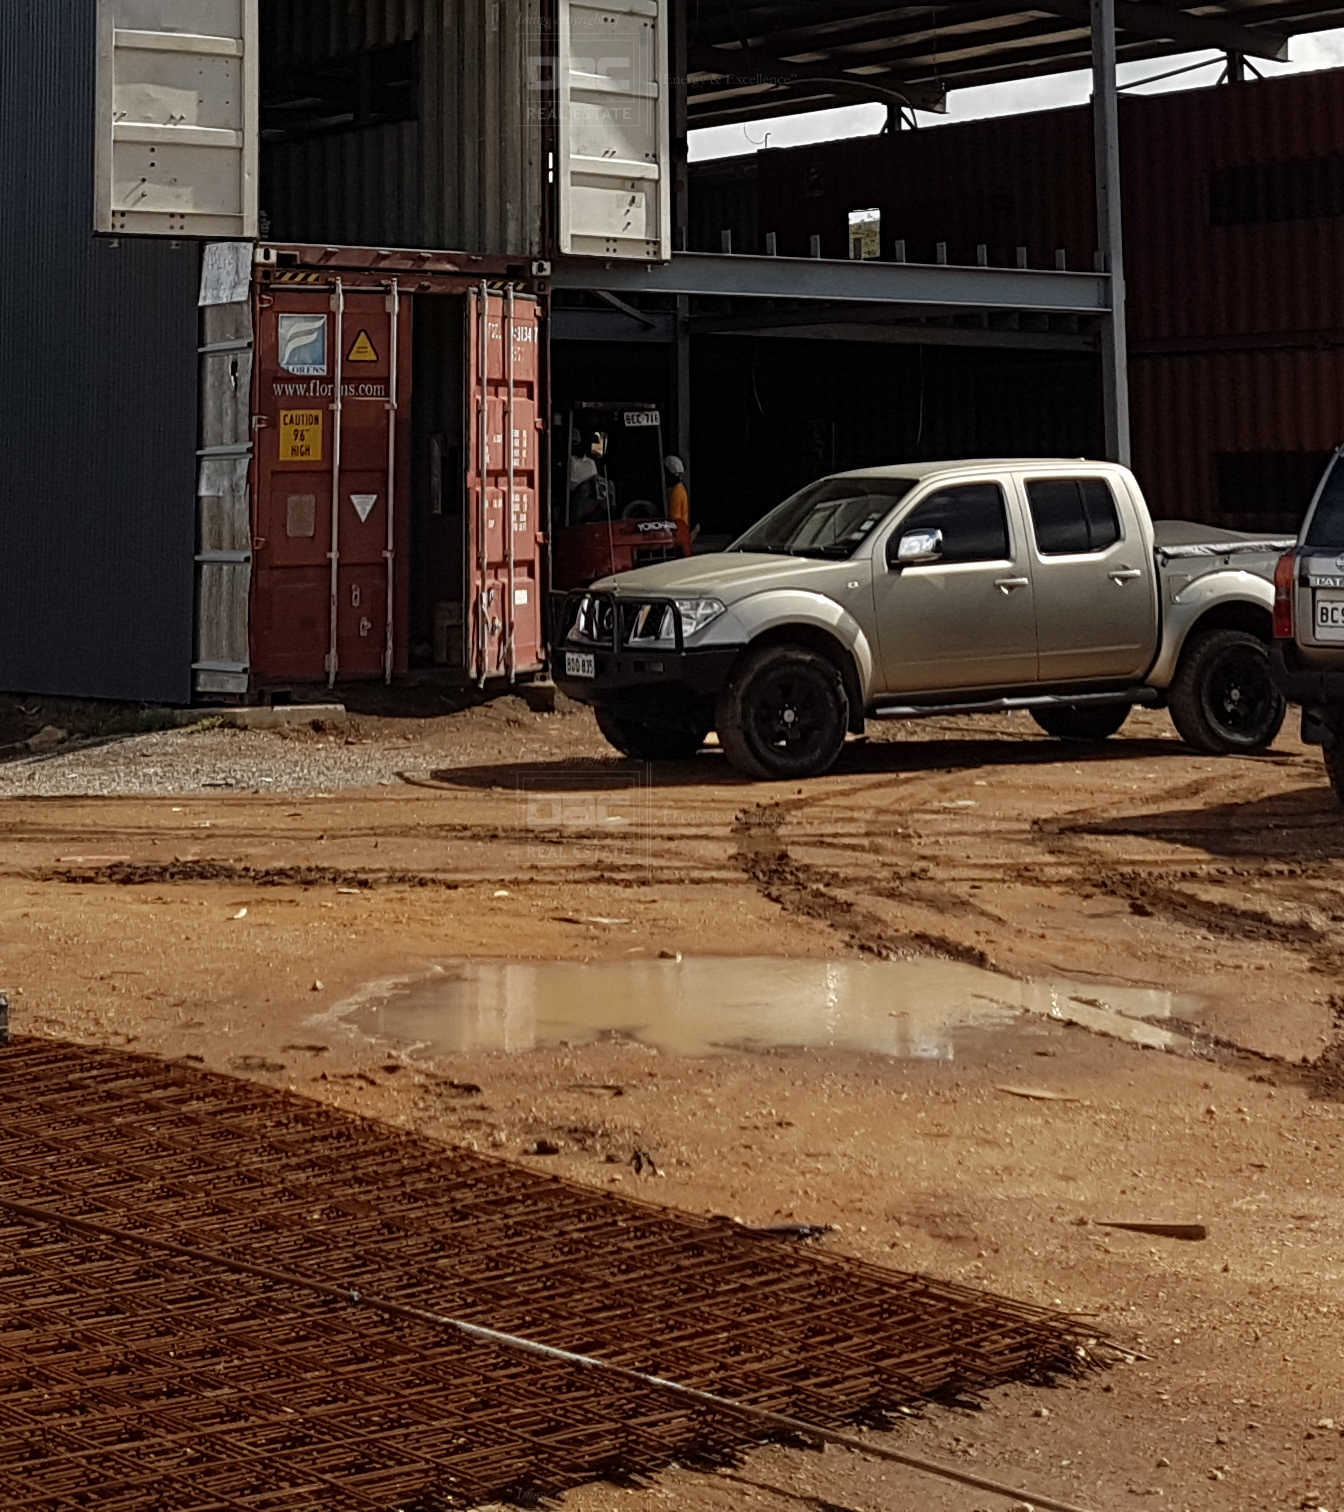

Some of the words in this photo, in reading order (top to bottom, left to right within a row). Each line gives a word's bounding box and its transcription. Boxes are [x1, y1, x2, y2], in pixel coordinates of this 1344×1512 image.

[287, 365, 326, 374] ORENS
[272, 379, 385, 397] www.florns.com
[283, 414, 319, 426] CAUTION
[290, 444, 311, 457] HIGH
